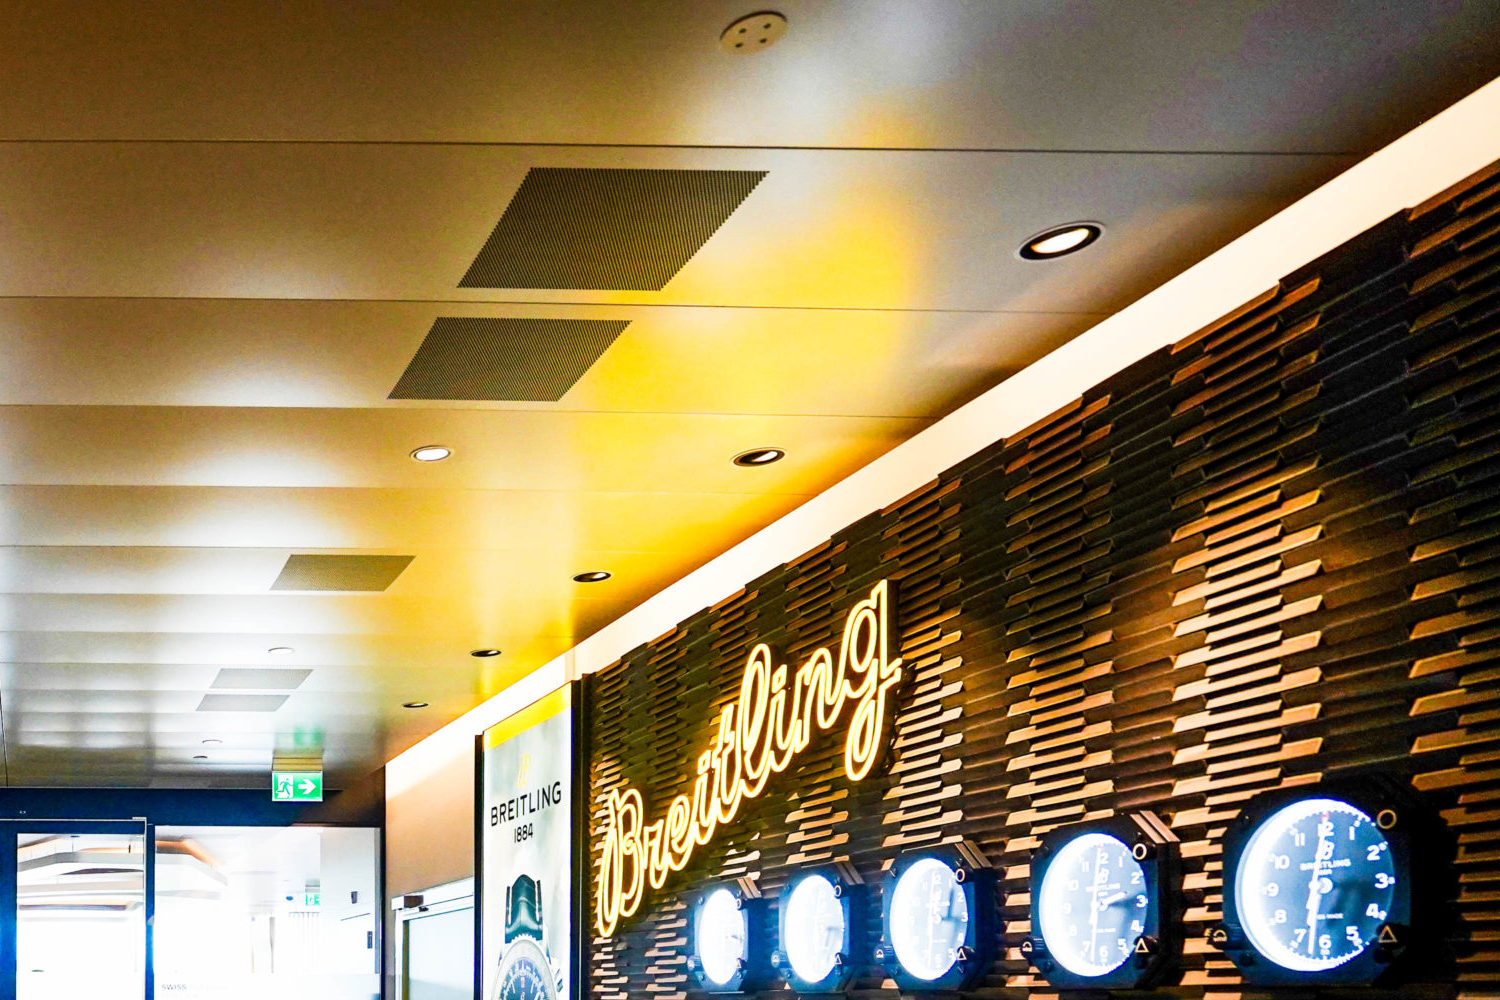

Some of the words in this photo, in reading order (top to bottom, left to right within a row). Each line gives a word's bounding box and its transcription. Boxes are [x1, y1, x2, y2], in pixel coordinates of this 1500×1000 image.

[596, 578, 903, 939] Breitling
[490, 781, 562, 827] BREITLING
[513, 822, 534, 844] 1884
[161, 983, 187, 991] SWISS
